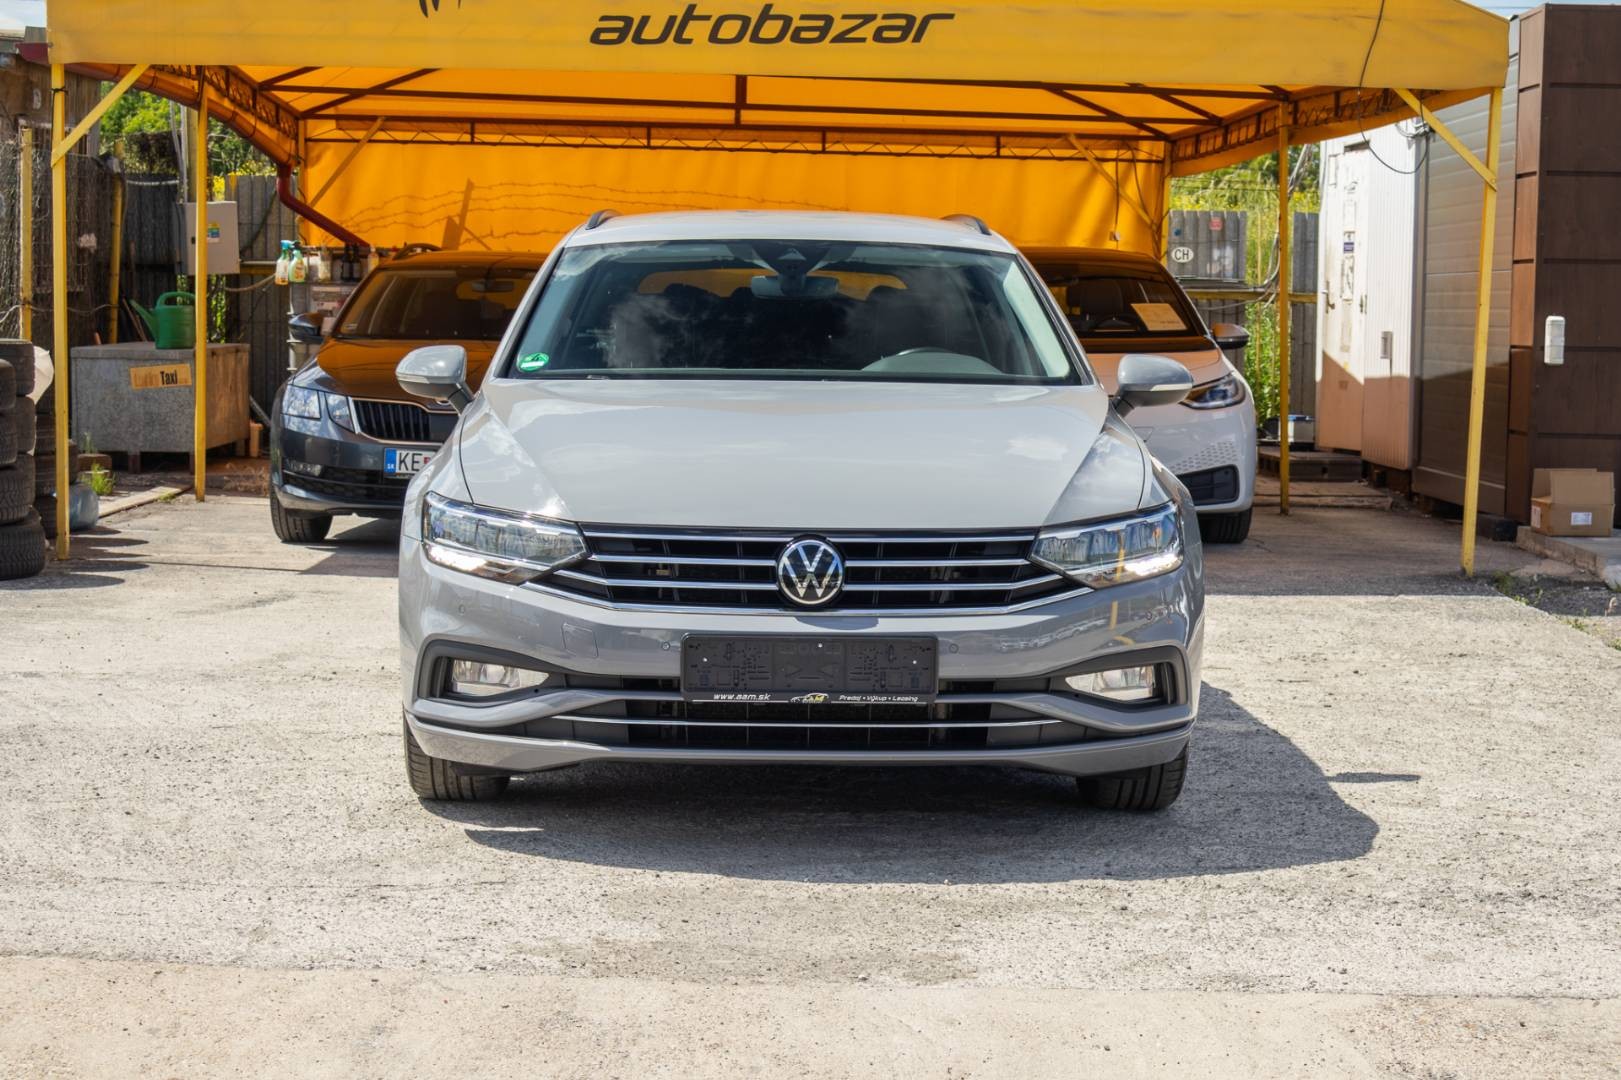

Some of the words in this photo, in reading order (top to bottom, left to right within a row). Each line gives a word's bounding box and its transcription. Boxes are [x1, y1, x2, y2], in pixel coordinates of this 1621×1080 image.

[589, 3, 955, 46] autobazar
[1174, 248, 1190, 261] CH
[159, 369, 178, 385] Taxi
[398, 452, 423, 472] KE
[713, 692, 771, 701] www.aam.sk
